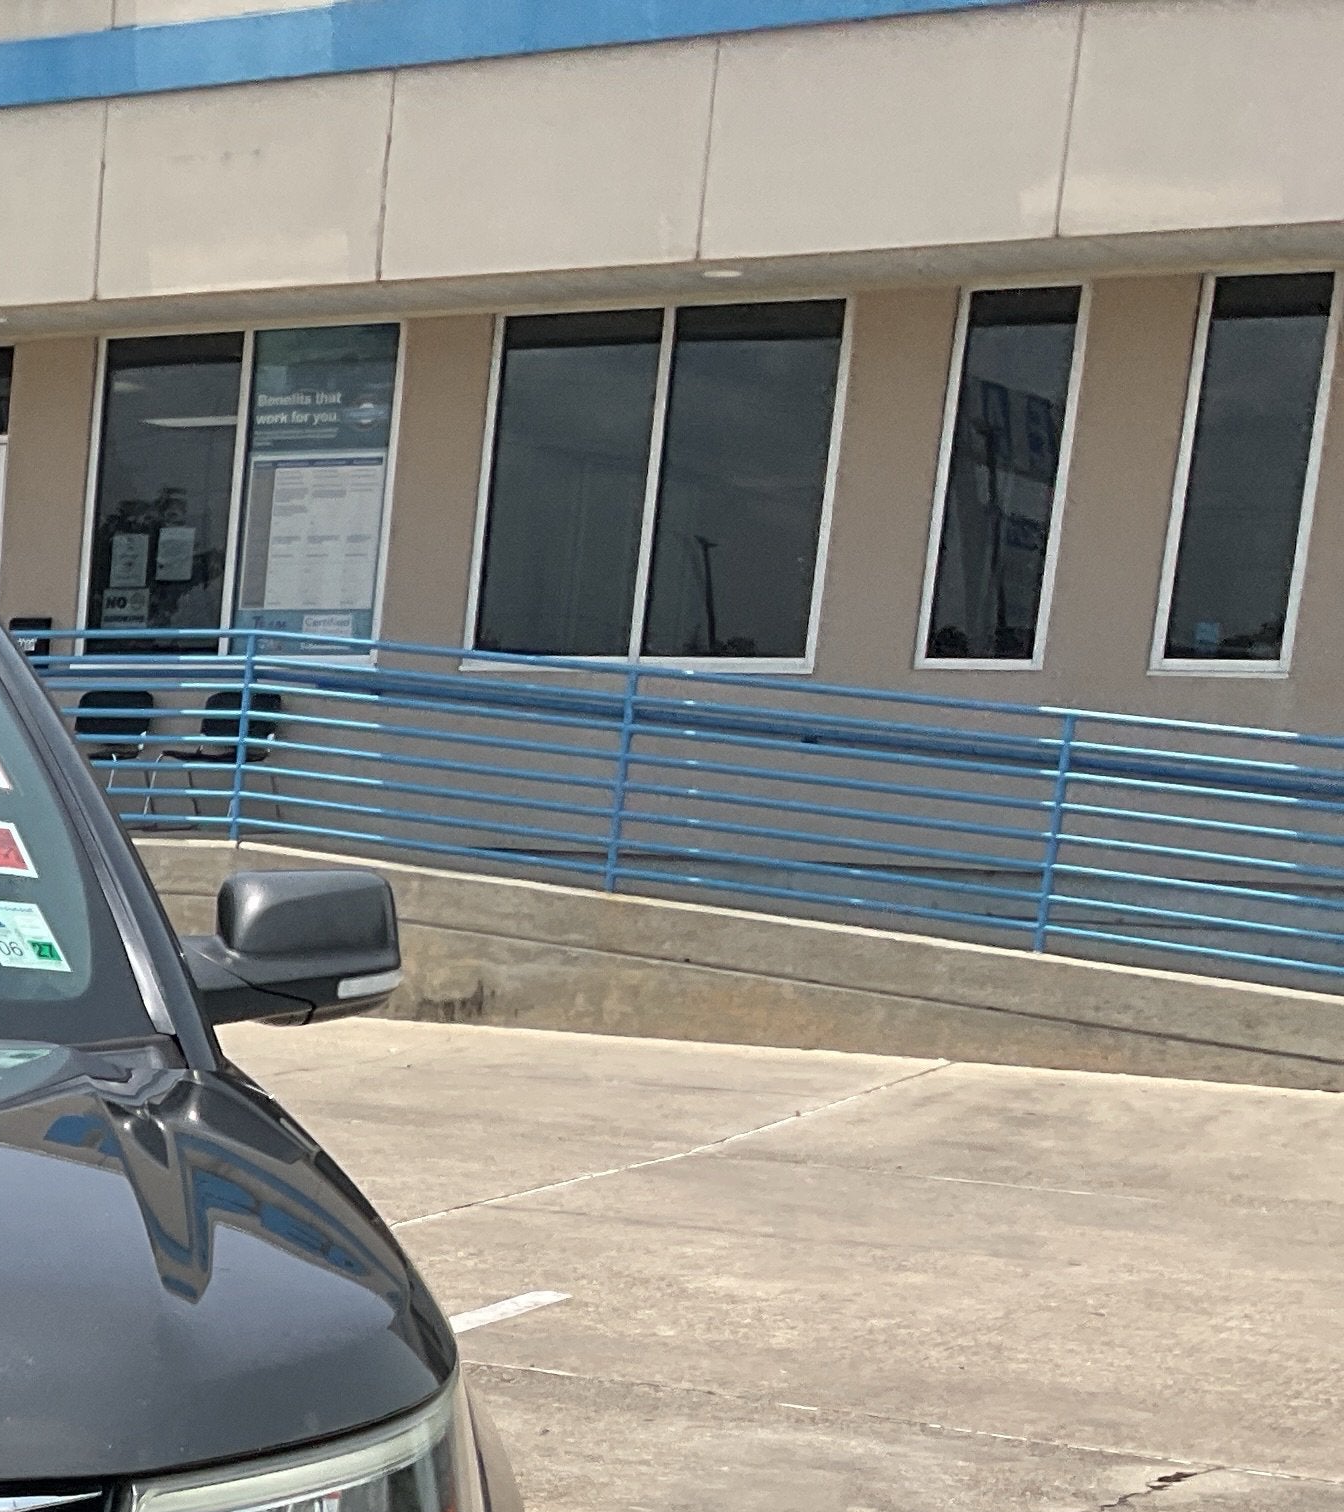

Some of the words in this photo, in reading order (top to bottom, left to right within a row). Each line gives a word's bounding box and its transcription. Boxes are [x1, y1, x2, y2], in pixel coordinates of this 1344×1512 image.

[316, 391, 341, 404] that
[255, 412, 287, 425] work
[292, 411, 309, 424] for
[106, 596, 127, 609] NO
[32, 942, 54, 958] 27
